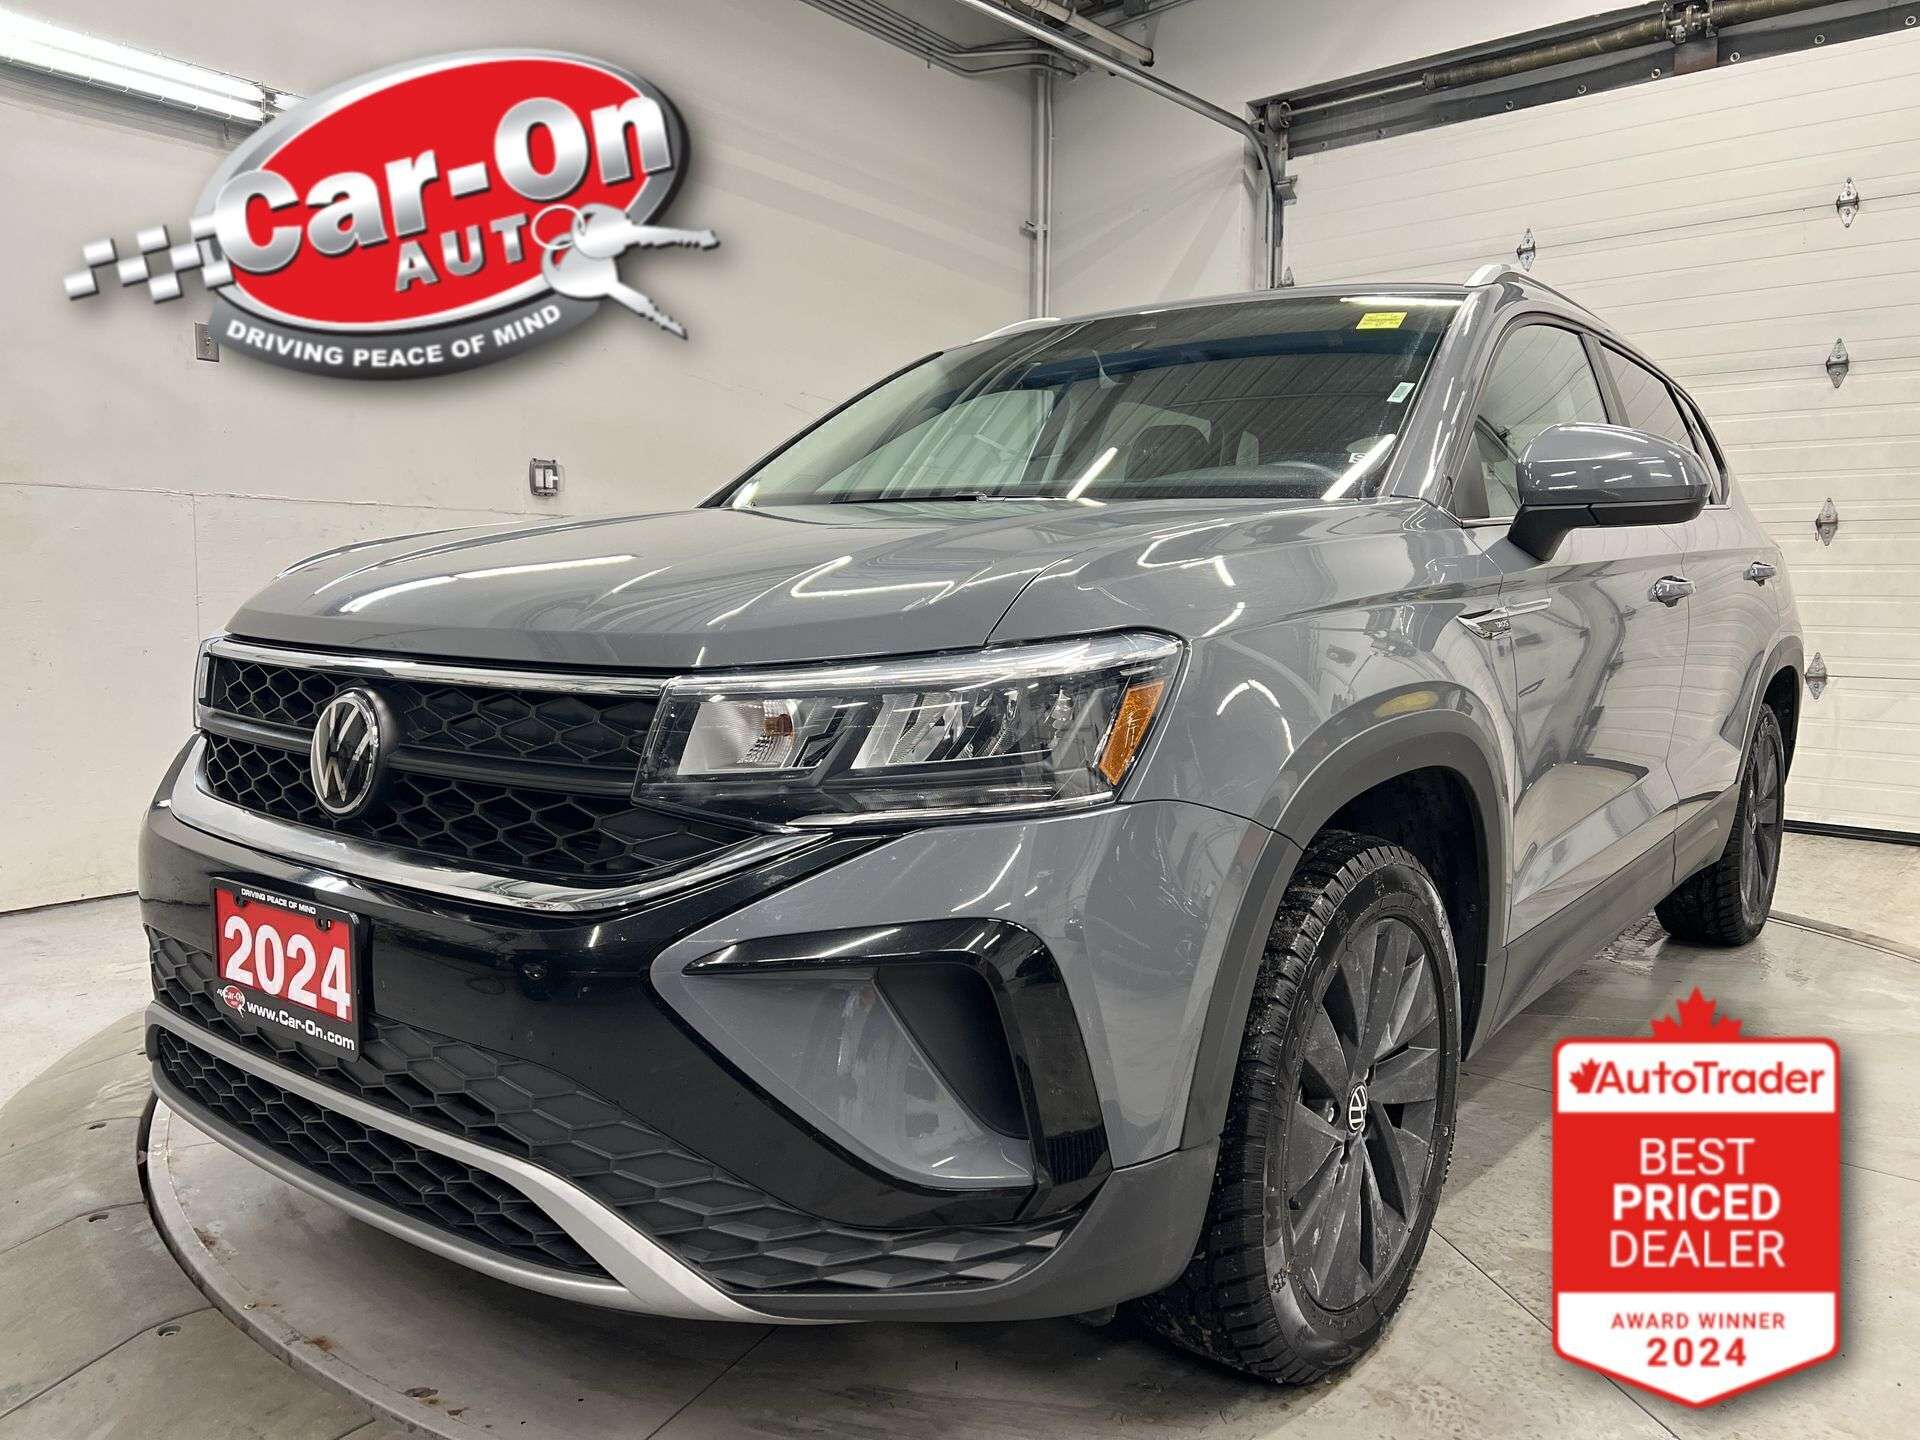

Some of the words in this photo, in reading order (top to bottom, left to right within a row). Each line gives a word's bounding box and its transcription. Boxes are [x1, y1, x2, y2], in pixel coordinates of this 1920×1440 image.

[266, 894, 288, 907] PEACE
[288, 901, 298, 910] OF
[298, 903, 317, 915] MIND
[224, 915, 351, 1020] 2024
[246, 1001, 355, 1051] www.Car-On.com
